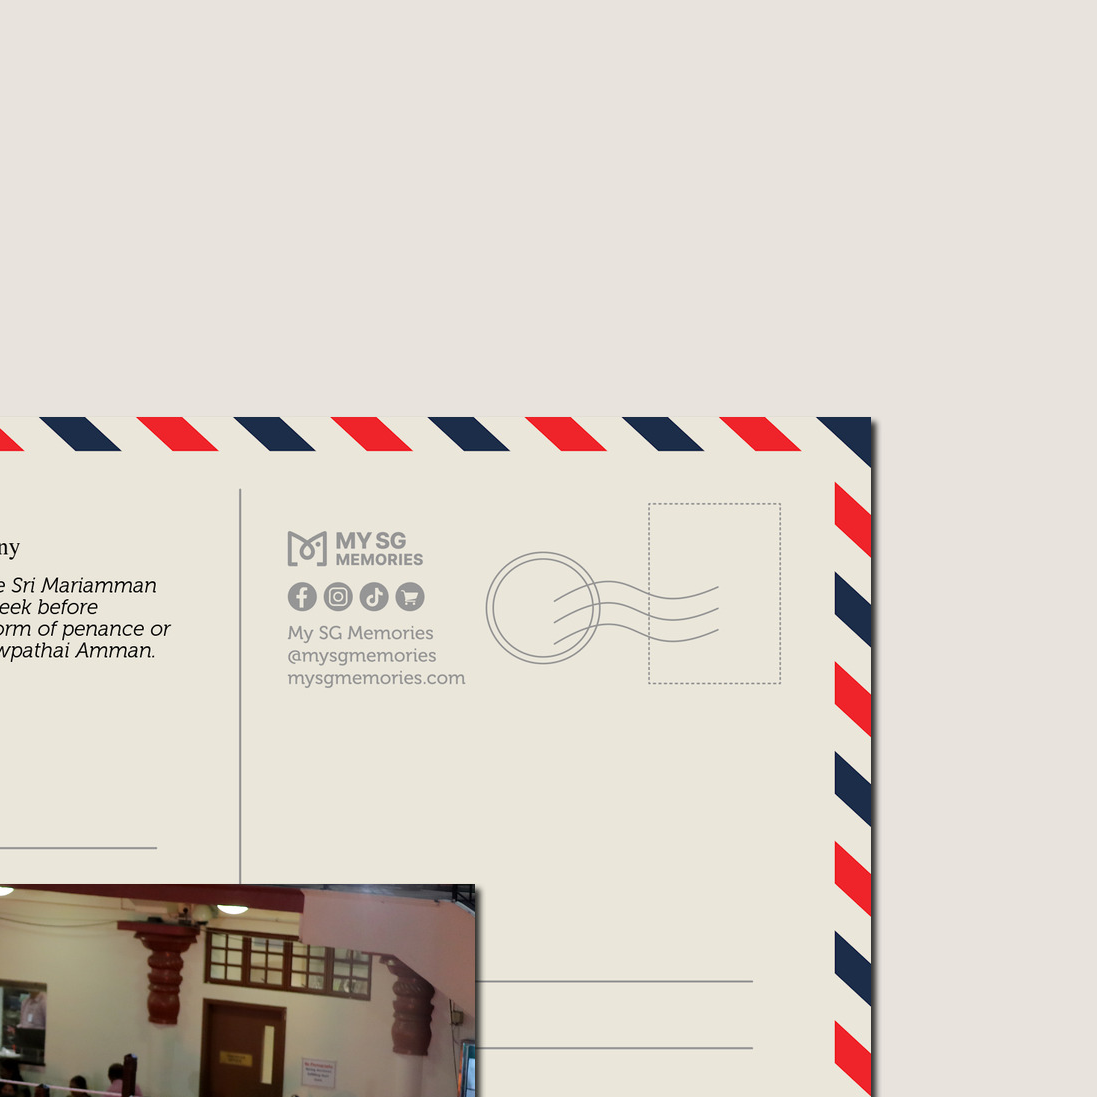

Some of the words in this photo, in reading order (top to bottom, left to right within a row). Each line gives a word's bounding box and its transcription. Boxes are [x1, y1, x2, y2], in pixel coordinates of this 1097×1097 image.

[336, 532, 372, 549] MY
[376, 532, 406, 549] SG
[336, 553, 423, 565] MEMORIES
[11, 577, 35, 593] Sri
[40, 577, 156, 593] Mariamman
[38, 599, 98, 615] before
[38, 620, 59, 636] of
[62, 624, 144, 641] penance
[151, 624, 171, 636] or
[288, 626, 314, 643] My
[319, 626, 342, 640] SG
[347, 626, 433, 640] Memories
[75, 642, 155, 658] Amman.
[288, 648, 436, 666] @mysgmemories
[288, 671, 466, 688] mysgmemories.com
